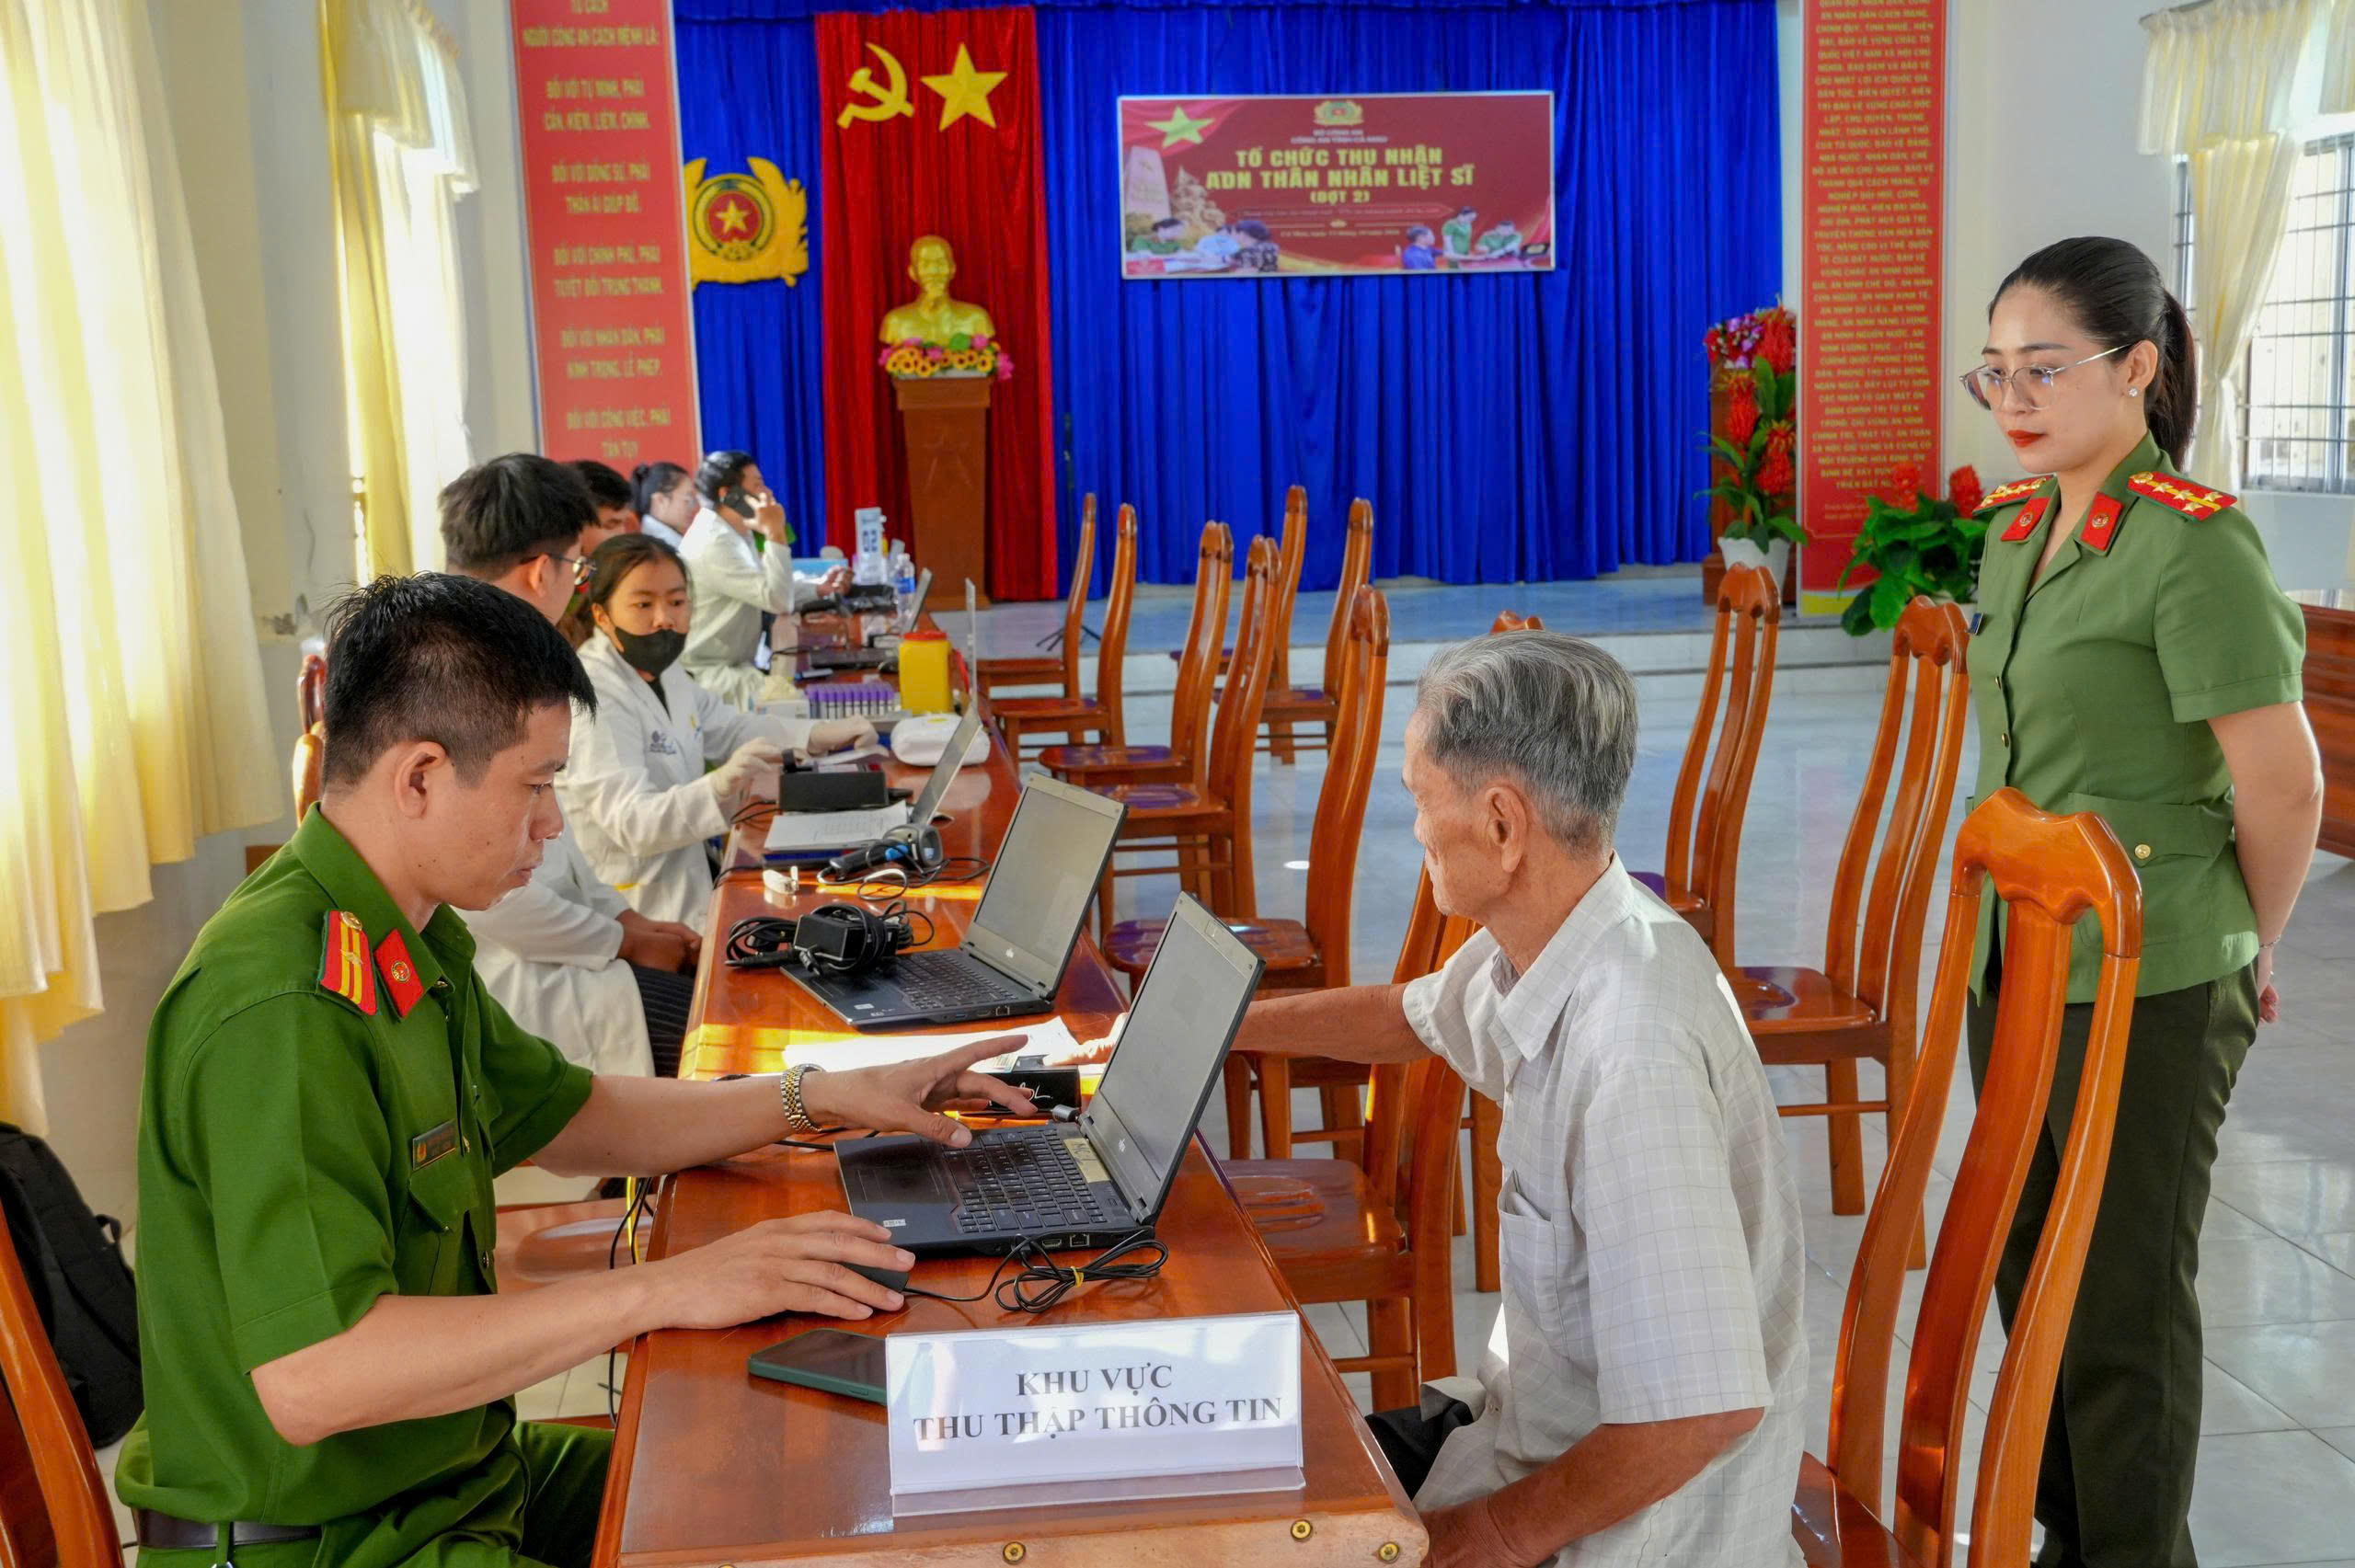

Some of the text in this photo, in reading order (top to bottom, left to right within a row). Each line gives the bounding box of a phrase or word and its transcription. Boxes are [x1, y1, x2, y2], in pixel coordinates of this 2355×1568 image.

[1236, 144, 1442, 167] TỔ CHỨC THU NHẬN
[1206, 171, 1252, 189] ADN
[1261, 168, 1319, 189] THÂN
[1327, 167, 1389, 188] NHÂN
[1397, 164, 1442, 190] LIỆT
[1017, 1362, 1174, 1396] KHU VỰC
[913, 1397, 1282, 1441] THU THẬP THÔNG TIN
